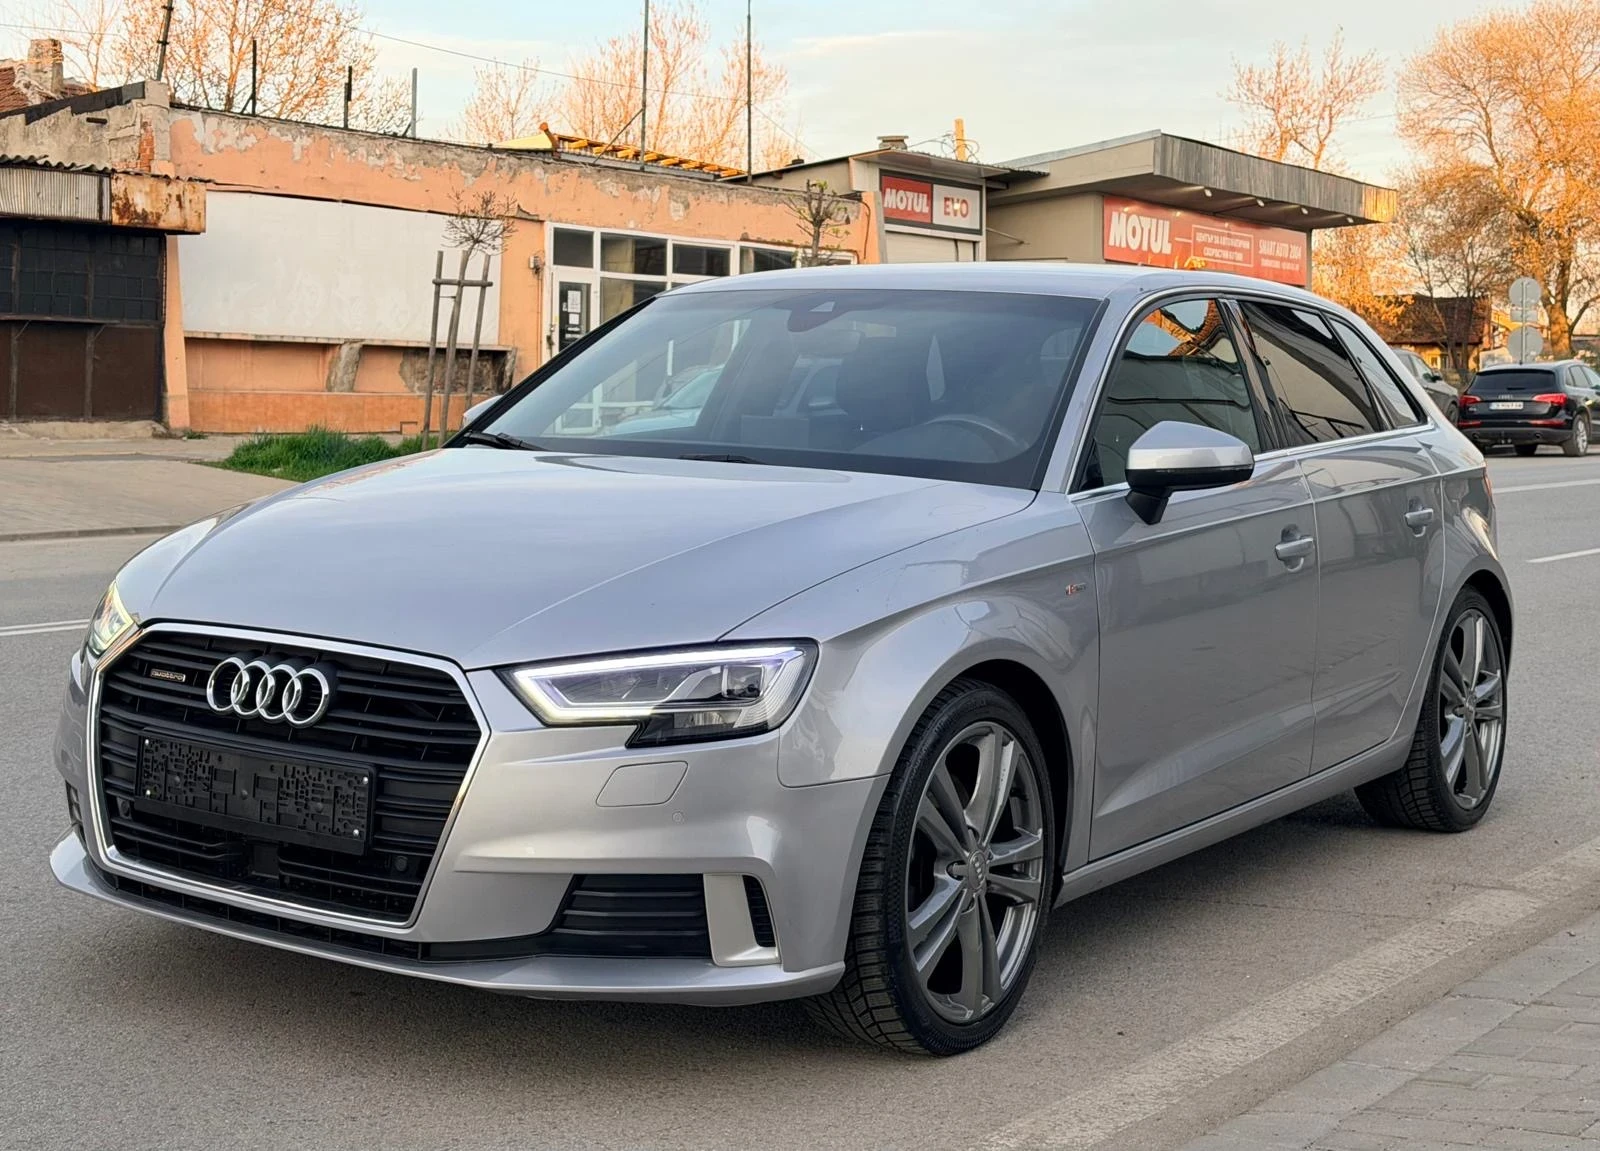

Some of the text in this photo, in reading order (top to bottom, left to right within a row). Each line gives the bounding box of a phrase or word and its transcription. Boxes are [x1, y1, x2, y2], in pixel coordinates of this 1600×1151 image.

[883, 188, 930, 213] MOTUL
[943, 196, 969, 218] EVO
[1108, 211, 1172, 255] MOTUL
